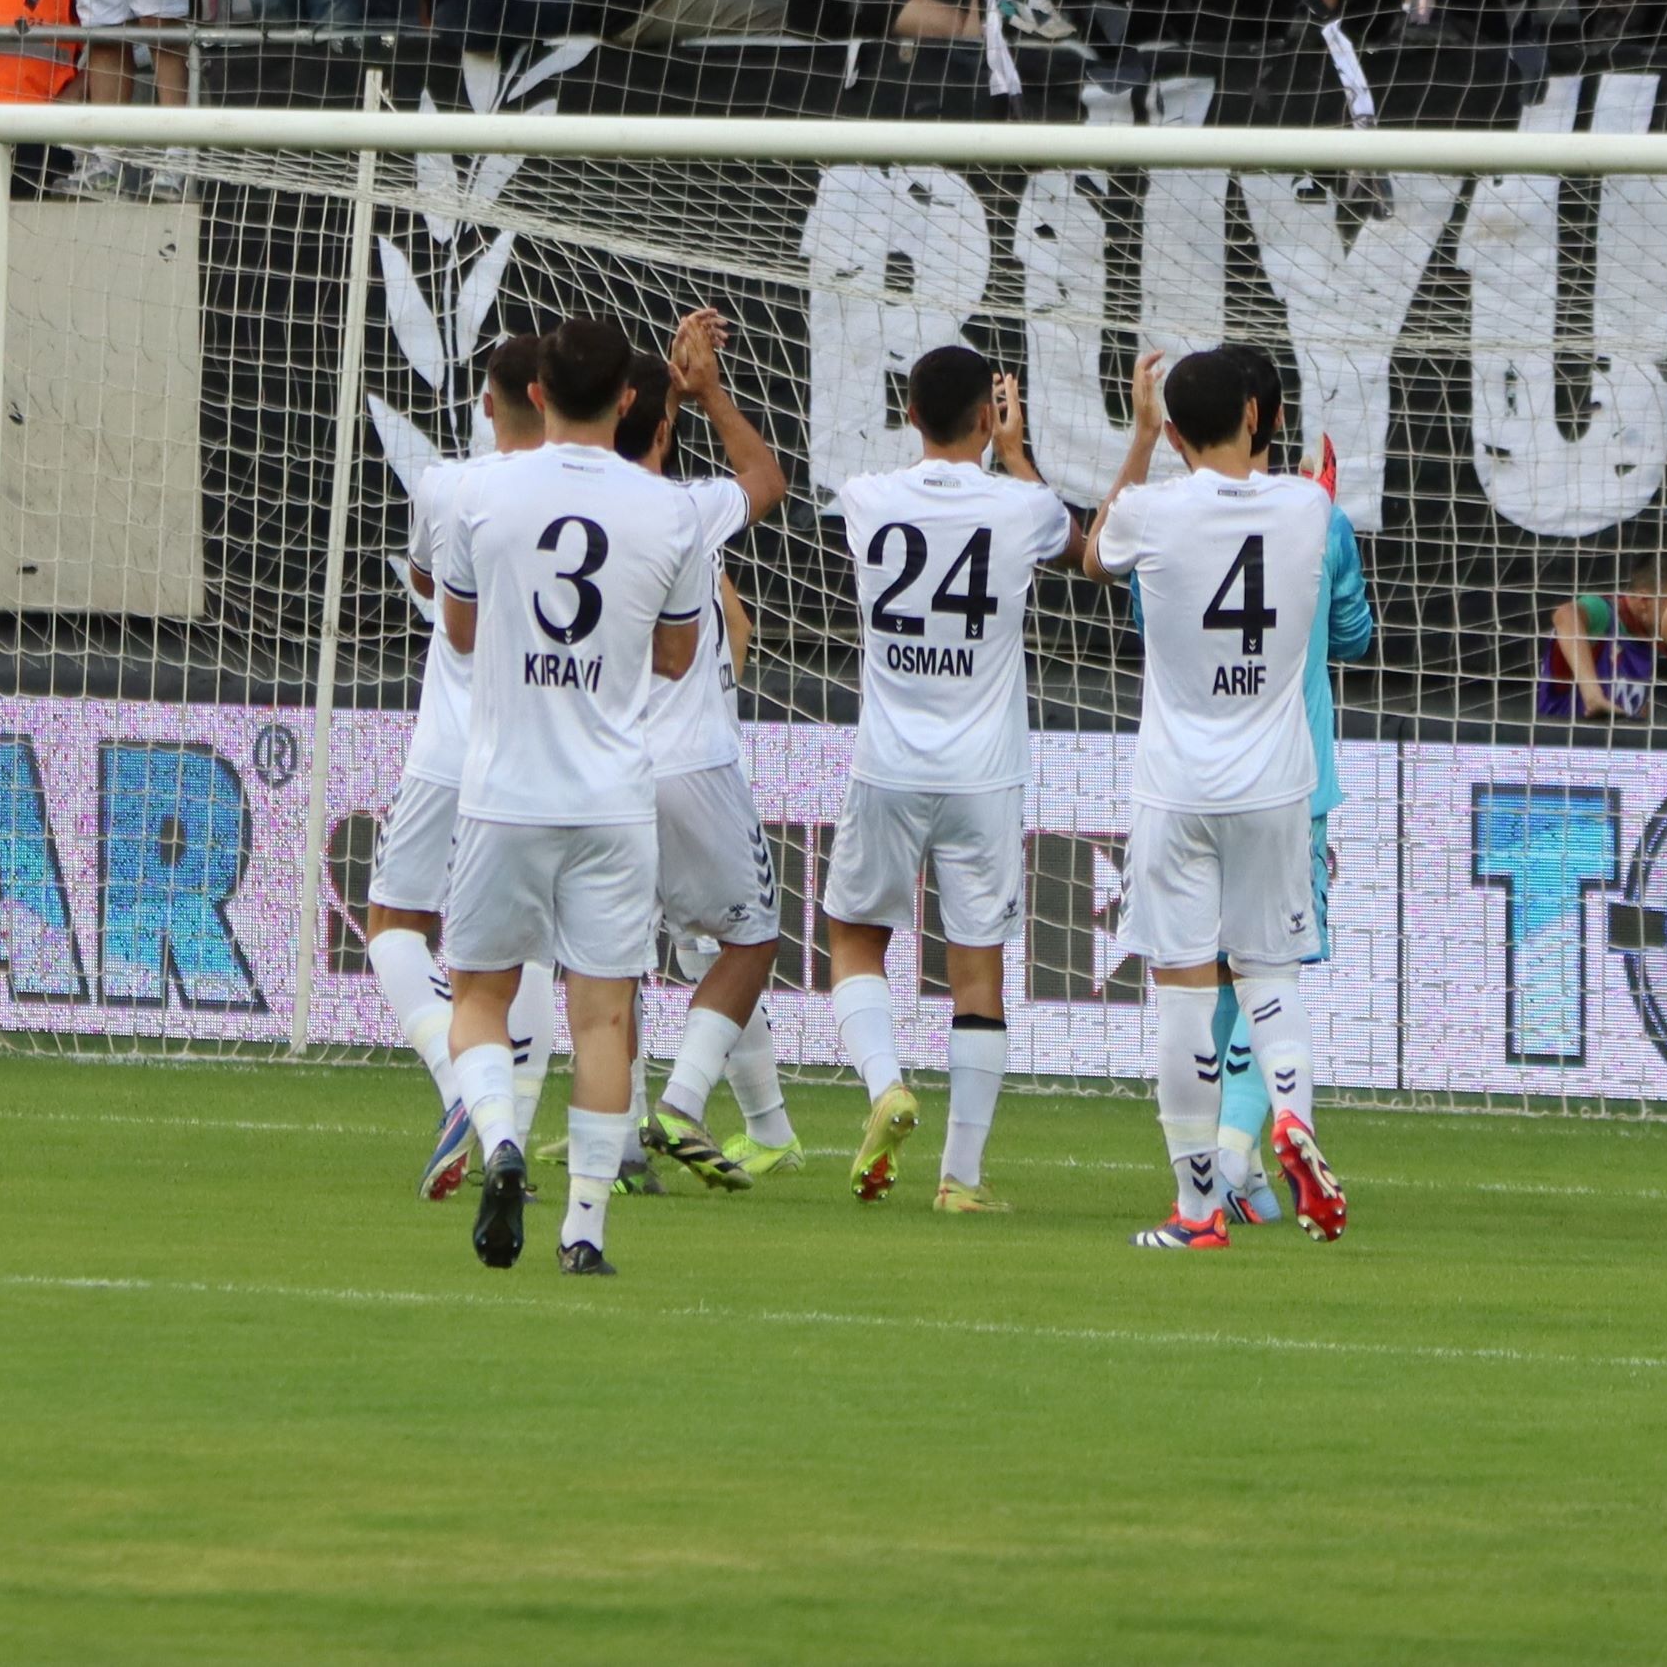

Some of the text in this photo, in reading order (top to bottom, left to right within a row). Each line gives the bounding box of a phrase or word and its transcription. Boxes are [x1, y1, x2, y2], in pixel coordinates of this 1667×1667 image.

[533, 515, 610, 647] 3
[867, 522, 999, 640] 24
[1202, 534, 1277, 656] 4
[886, 643, 975, 678] OSMAN
[1212, 659, 1267, 696] ARİF
